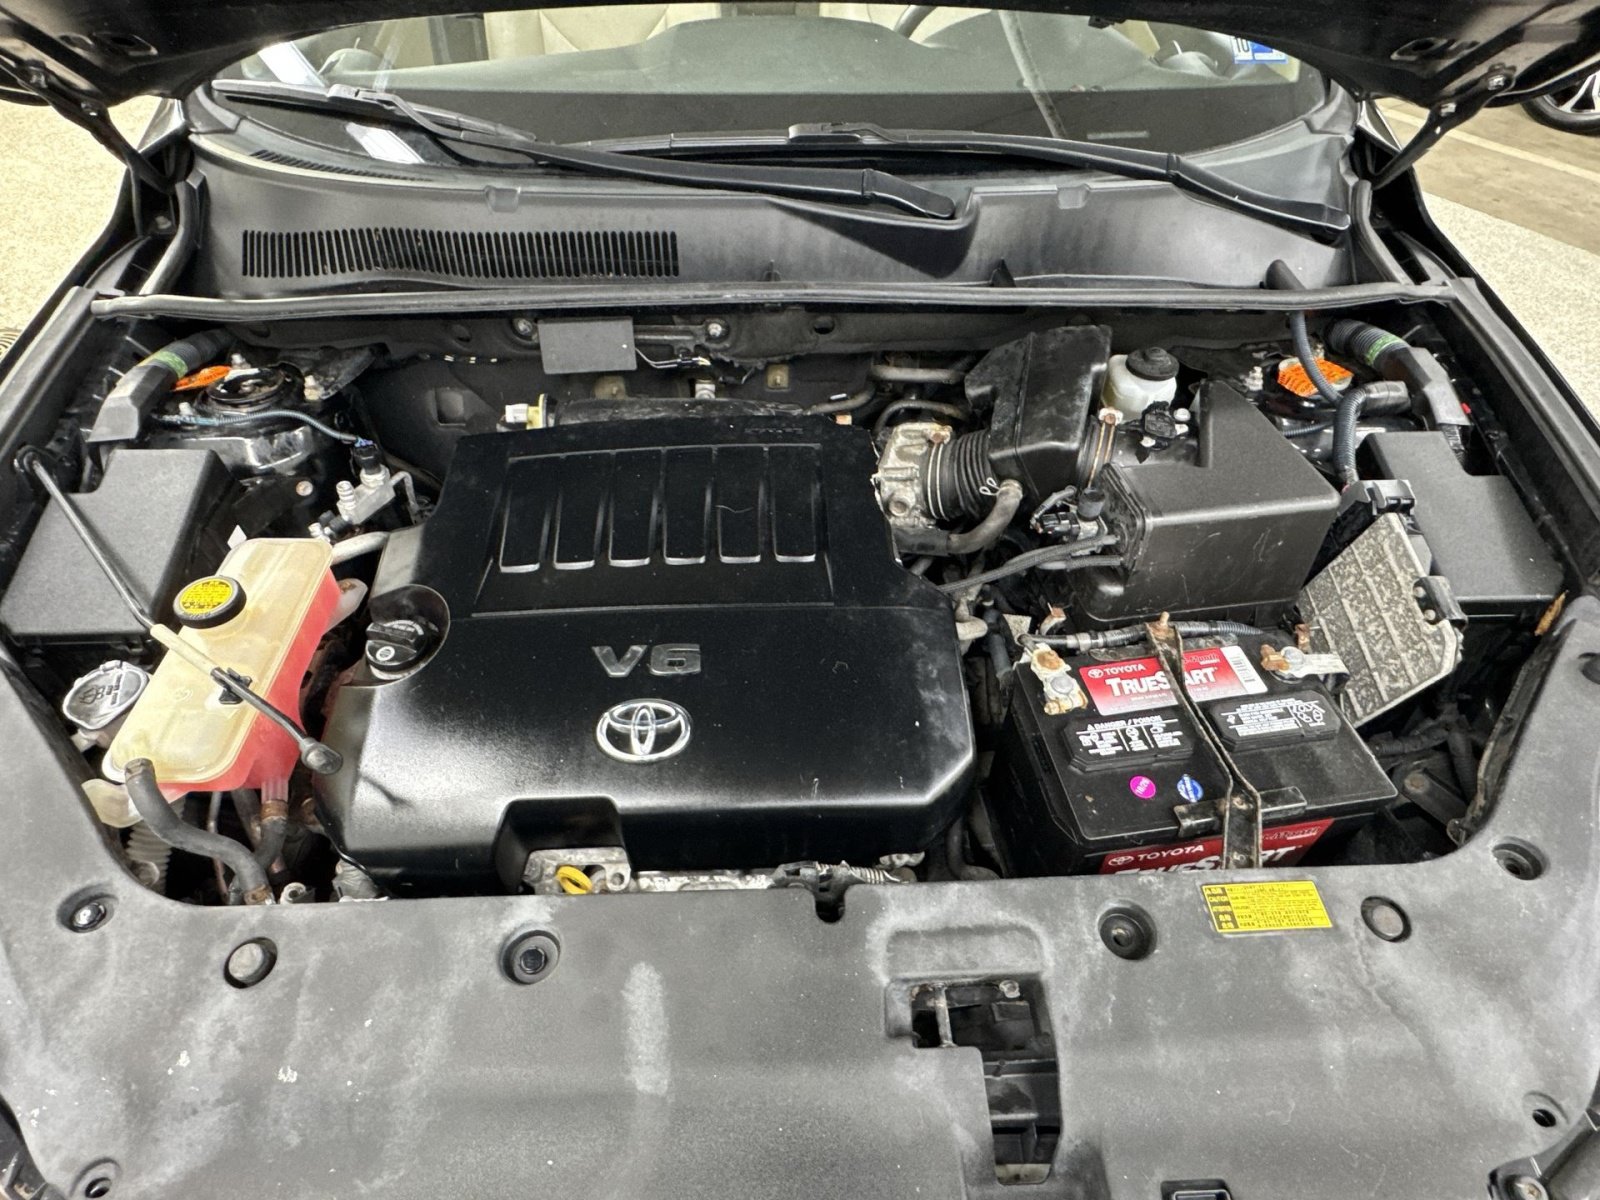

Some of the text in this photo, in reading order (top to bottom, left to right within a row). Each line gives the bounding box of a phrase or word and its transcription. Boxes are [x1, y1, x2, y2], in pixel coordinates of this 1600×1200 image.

[591, 643, 701, 677] V6
[1103, 663, 1147, 676] TOYOTA
[1137, 844, 1205, 862] TOYOTA
